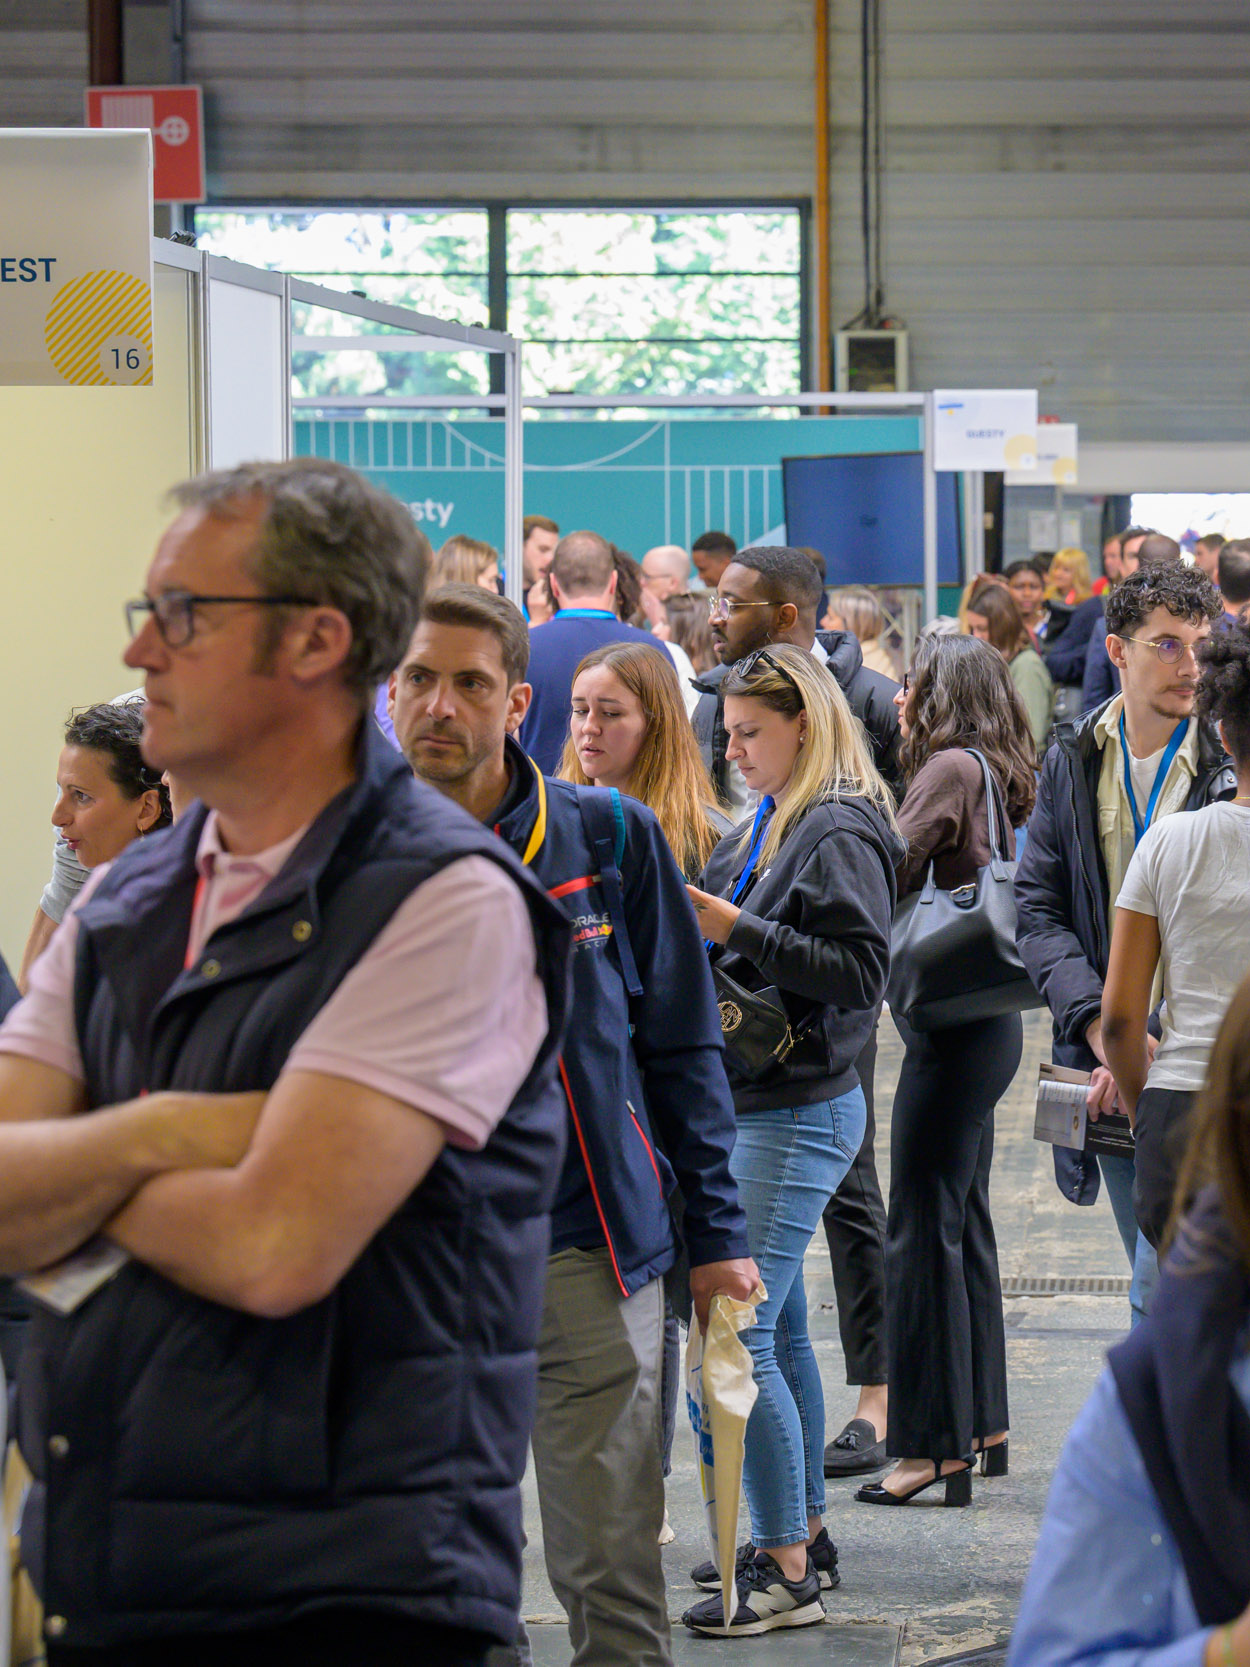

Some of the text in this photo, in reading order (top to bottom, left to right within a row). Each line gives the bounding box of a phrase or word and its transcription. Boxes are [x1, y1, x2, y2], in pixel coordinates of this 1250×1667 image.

[0, 257, 57, 283] EST
[111, 348, 140, 370] 16
[401, 497, 455, 529] sty
